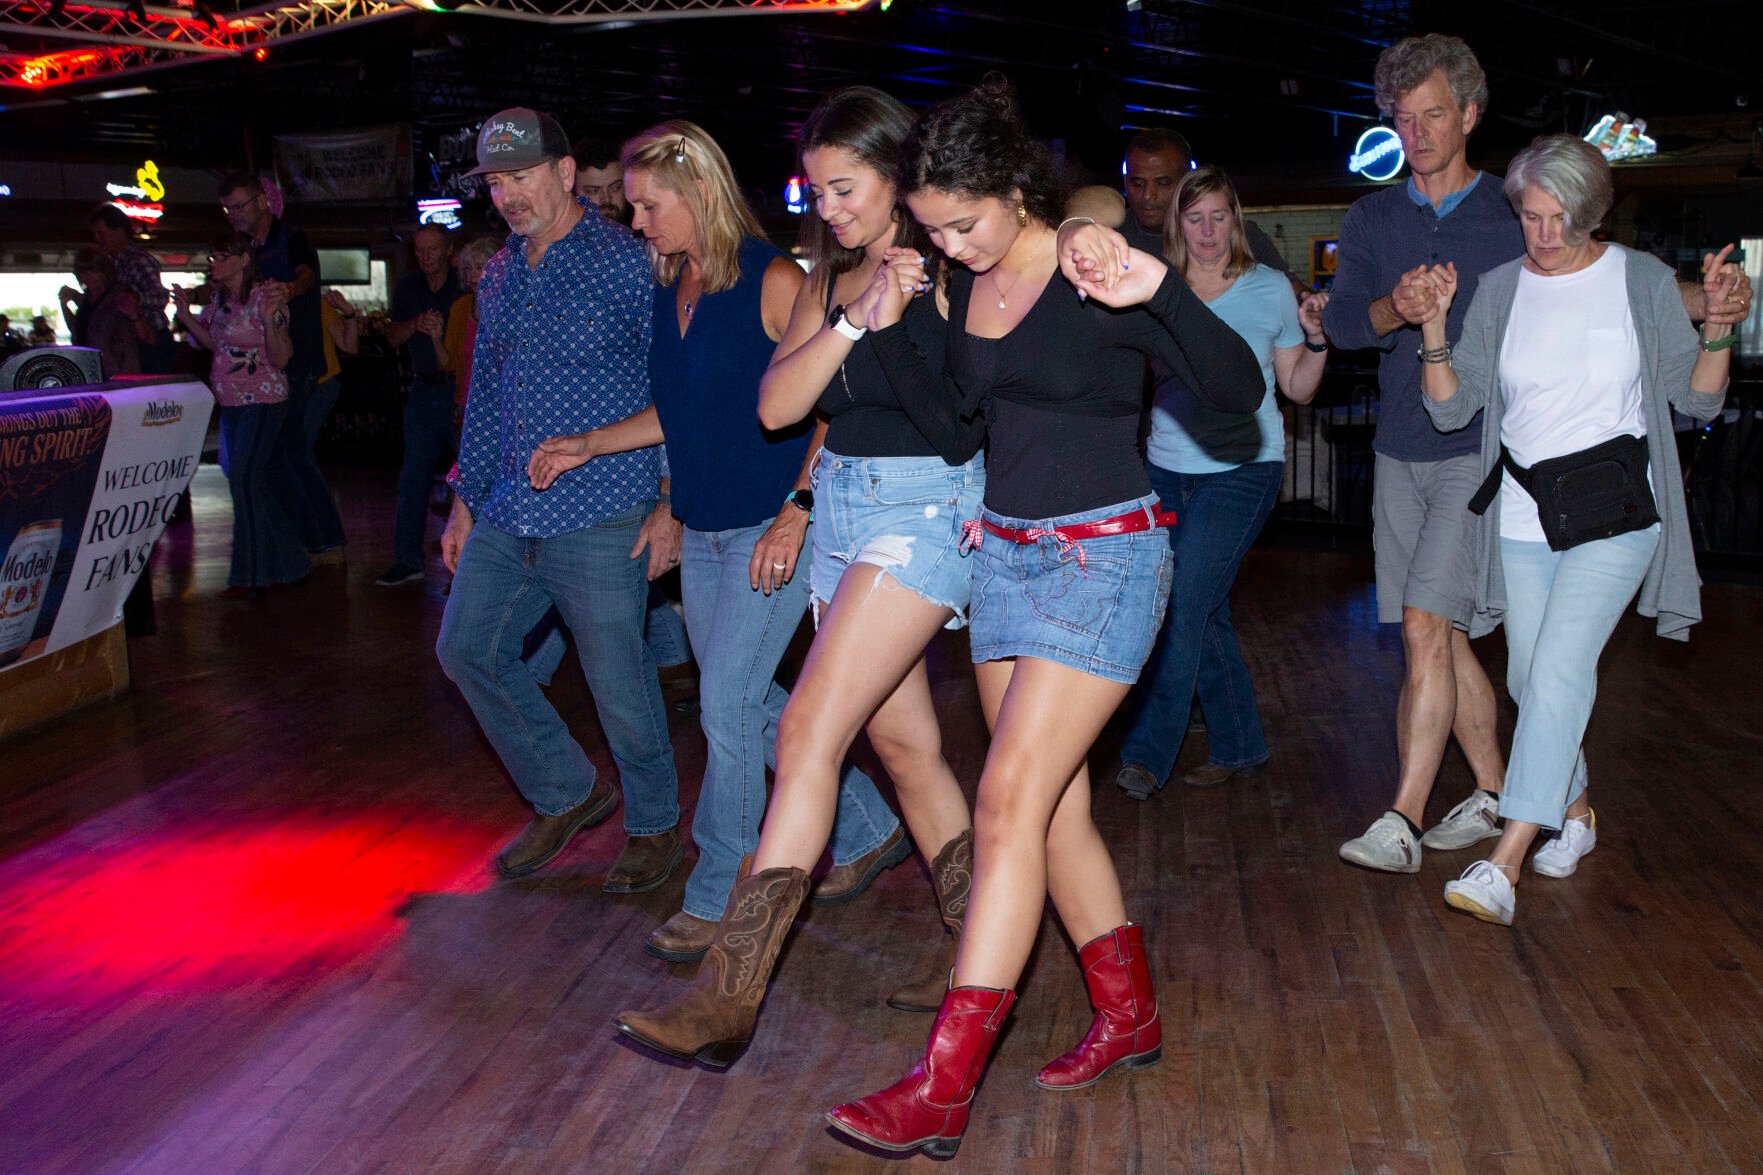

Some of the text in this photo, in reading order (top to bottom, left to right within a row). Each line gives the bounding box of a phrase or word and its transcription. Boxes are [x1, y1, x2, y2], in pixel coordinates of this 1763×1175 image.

[505, 121, 526, 139] Bent
[486, 143, 500, 154] Hat
[36, 409, 58, 428] OUT
[57, 406, 81, 425] THE
[148, 400, 180, 420] Modelo
[104, 456, 194, 493] WELCOME
[1, 550, 53, 583] Modelo
[84, 542, 150, 593] FANS
